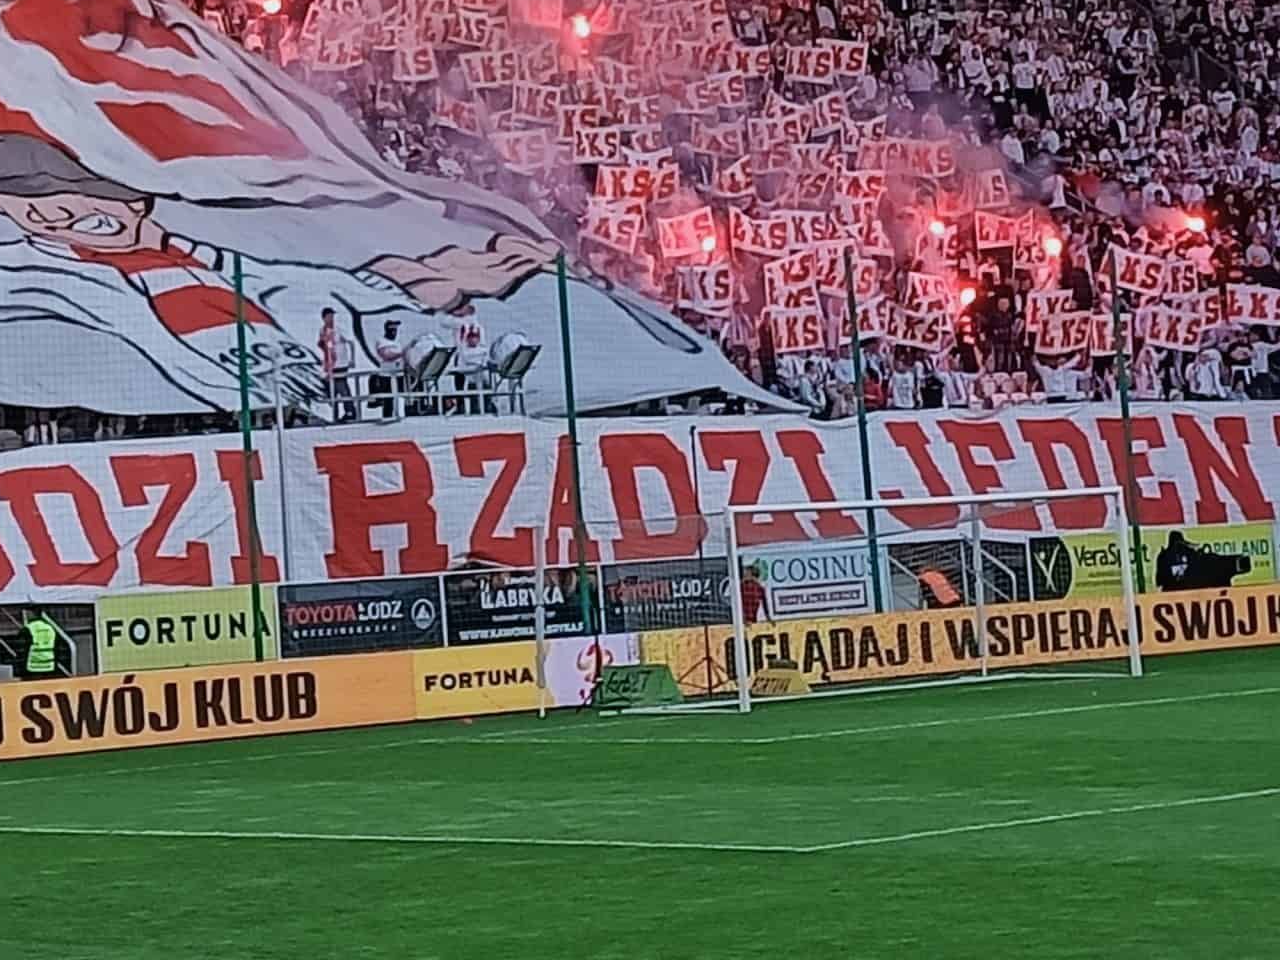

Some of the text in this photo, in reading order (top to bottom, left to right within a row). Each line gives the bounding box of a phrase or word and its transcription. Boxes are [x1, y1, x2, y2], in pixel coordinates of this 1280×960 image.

[832, 46, 864, 71] KS
[564, 108, 599, 137] KS
[576, 131, 617, 158] ŁKS
[774, 316, 818, 348] ŁKS
[1149, 311, 1201, 345] ŁKS
[878, 413, 1275, 530] JEDEN
[105, 611, 271, 647] FORTUNA
[285, 601, 357, 625] TOYOTA
[725, 623, 910, 682] OGLĄDAJ
[920, 621, 933, 663] I
[944, 605, 1144, 661] WSPIERAJ
[1154, 591, 1258, 644] SWÓJ
[425, 668, 534, 691] FORTUNA
[20, 673, 179, 744] SWÓJ
[196, 671, 317, 727] KLUB
